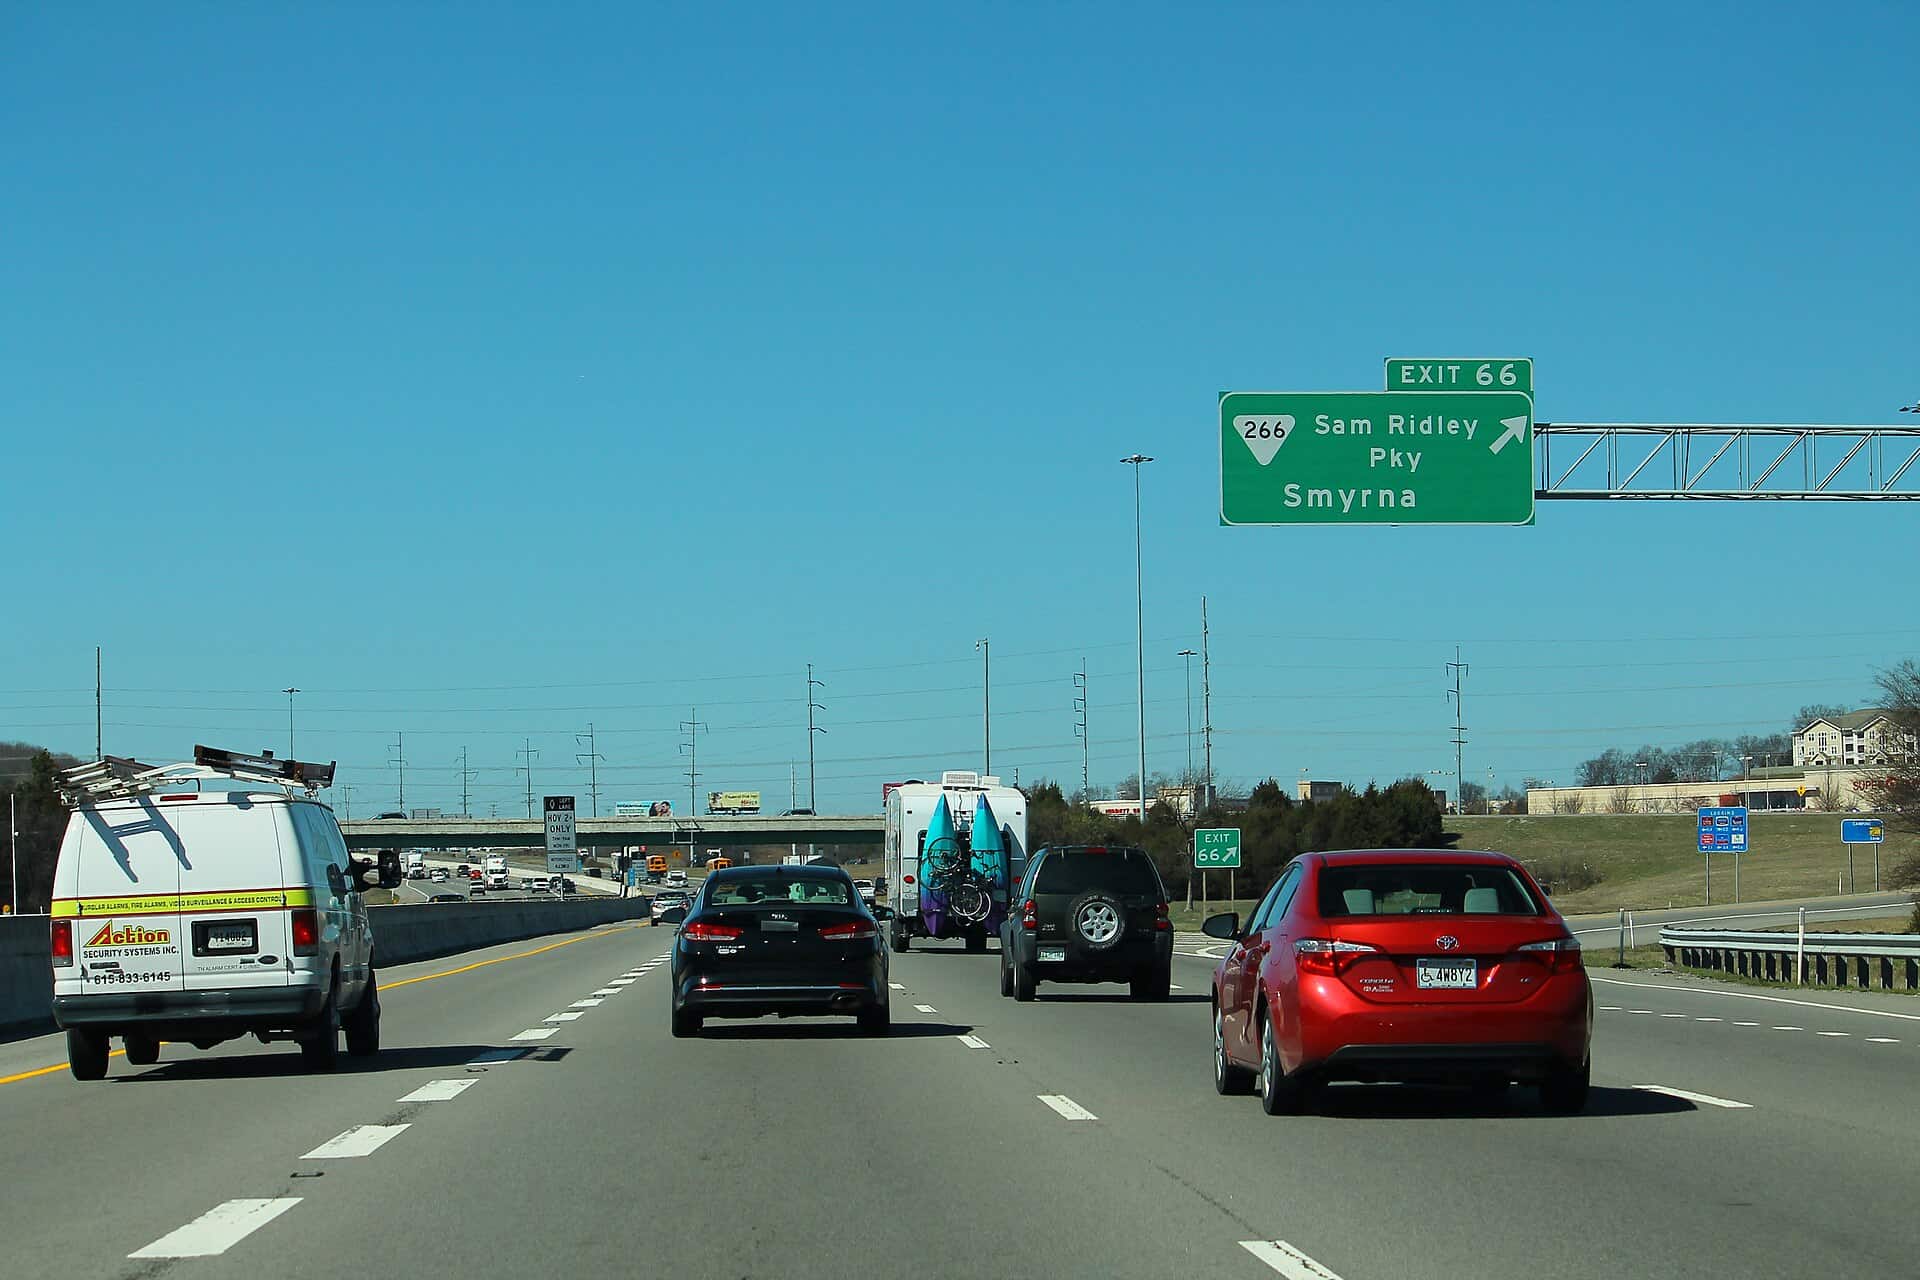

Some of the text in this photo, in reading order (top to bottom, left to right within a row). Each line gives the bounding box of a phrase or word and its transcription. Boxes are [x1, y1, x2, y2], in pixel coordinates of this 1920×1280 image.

[1401, 363, 1518, 386] EXIT 66
[1244, 420, 1286, 439] 266
[1315, 414, 1479, 441] Sam Ridley
[1370, 447, 1423, 472] Pky
[1283, 484, 1417, 513] Smyrna
[548, 814, 561, 822] HOV
[550, 825, 571, 833] ONLY
[1204, 833, 1230, 843] EXIT
[1198, 848, 1220, 861] 66
[186, 898, 227, 906] SURVEILLANCE
[83, 919, 170, 947] Action
[83, 946, 179, 958] SECURITY SYSTEMS INC.
[94, 971, 171, 985] 615-833-6145
[1436, 968, 1473, 982] 4W8Y2
